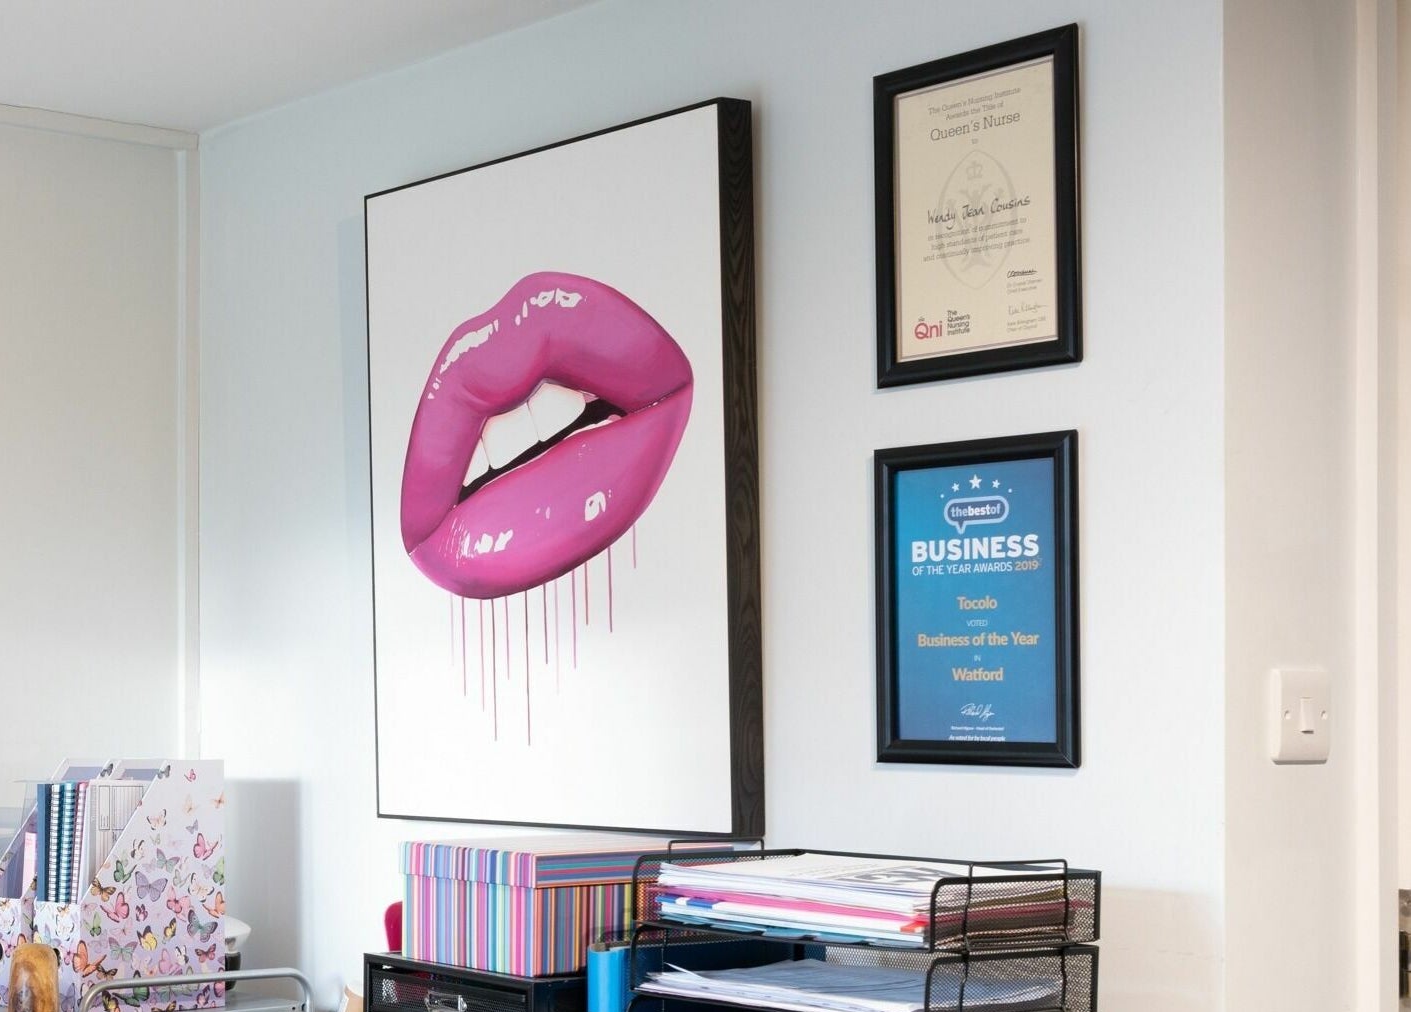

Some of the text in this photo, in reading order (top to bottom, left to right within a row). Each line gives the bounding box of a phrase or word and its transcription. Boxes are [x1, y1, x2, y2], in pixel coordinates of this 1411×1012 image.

[930, 112, 1020, 140] Queen's Nurse
[927, 208, 955, 230] Wendy
[990, 196, 1030, 214] Cousins
[914, 321, 943, 340] Qni
[951, 503, 1001, 518] thebestof
[911, 534, 1040, 563] BUSINESS
[912, 561, 1039, 576] OF THE YEAR AWARDS 2019
[957, 596, 998, 610] Tocolo
[917, 631, 1040, 647] Business of the Year
[952, 667, 1004, 681] Watford
